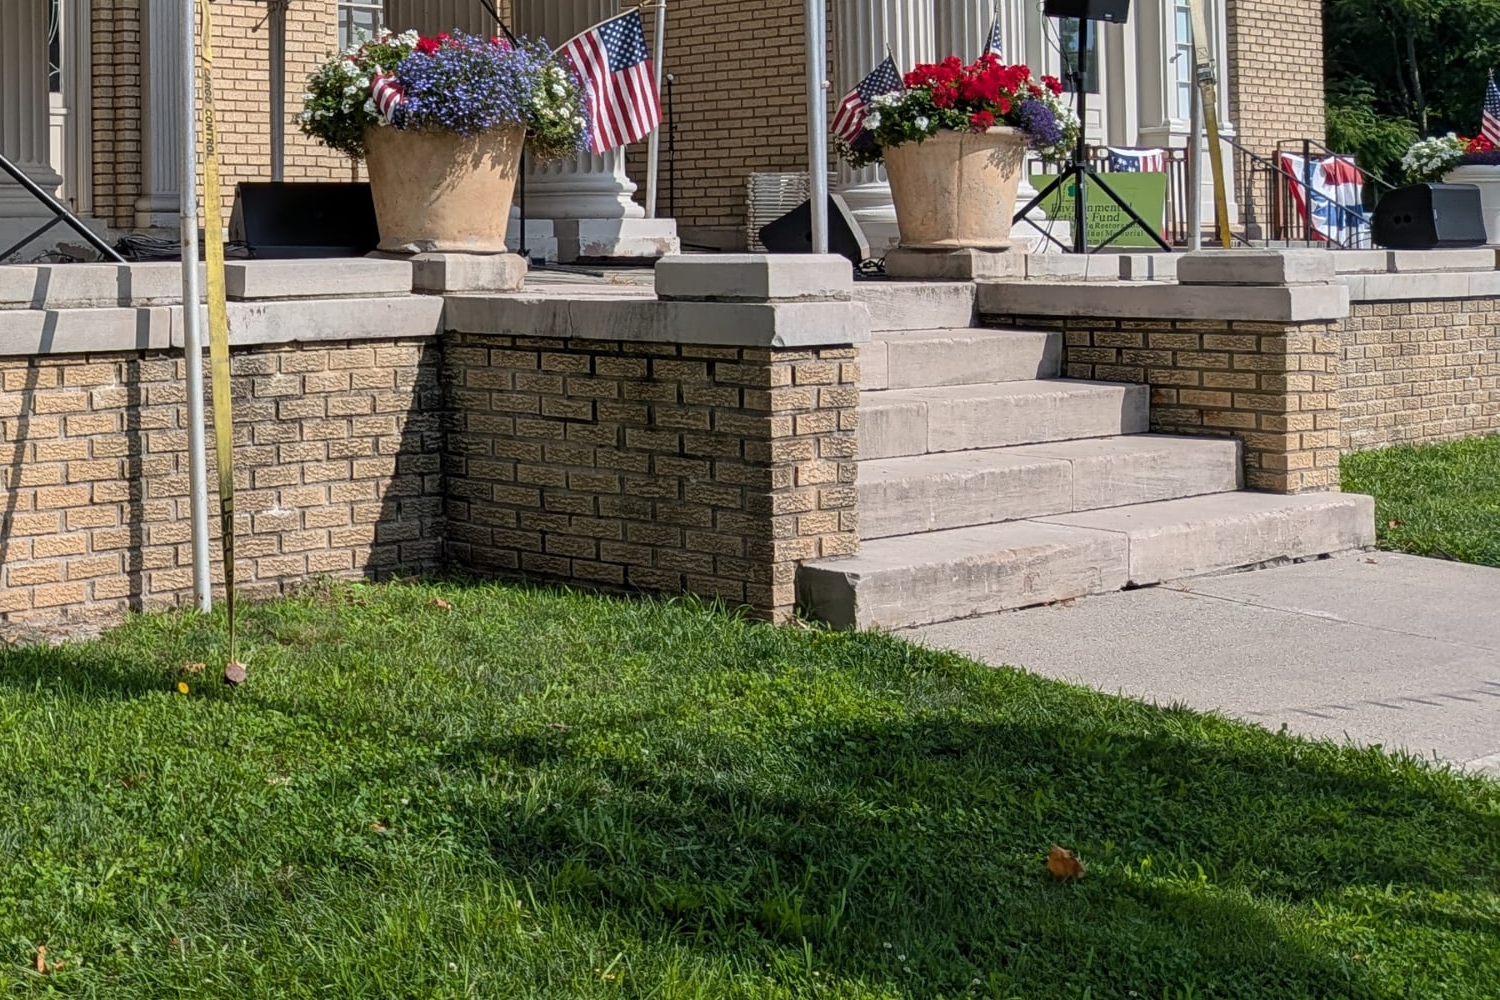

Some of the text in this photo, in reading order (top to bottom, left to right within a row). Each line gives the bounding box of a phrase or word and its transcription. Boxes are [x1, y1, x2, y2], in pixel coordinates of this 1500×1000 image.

[204, 68, 215, 158] CARGO CONTROL
[1092, 212, 1120, 221] Fund
